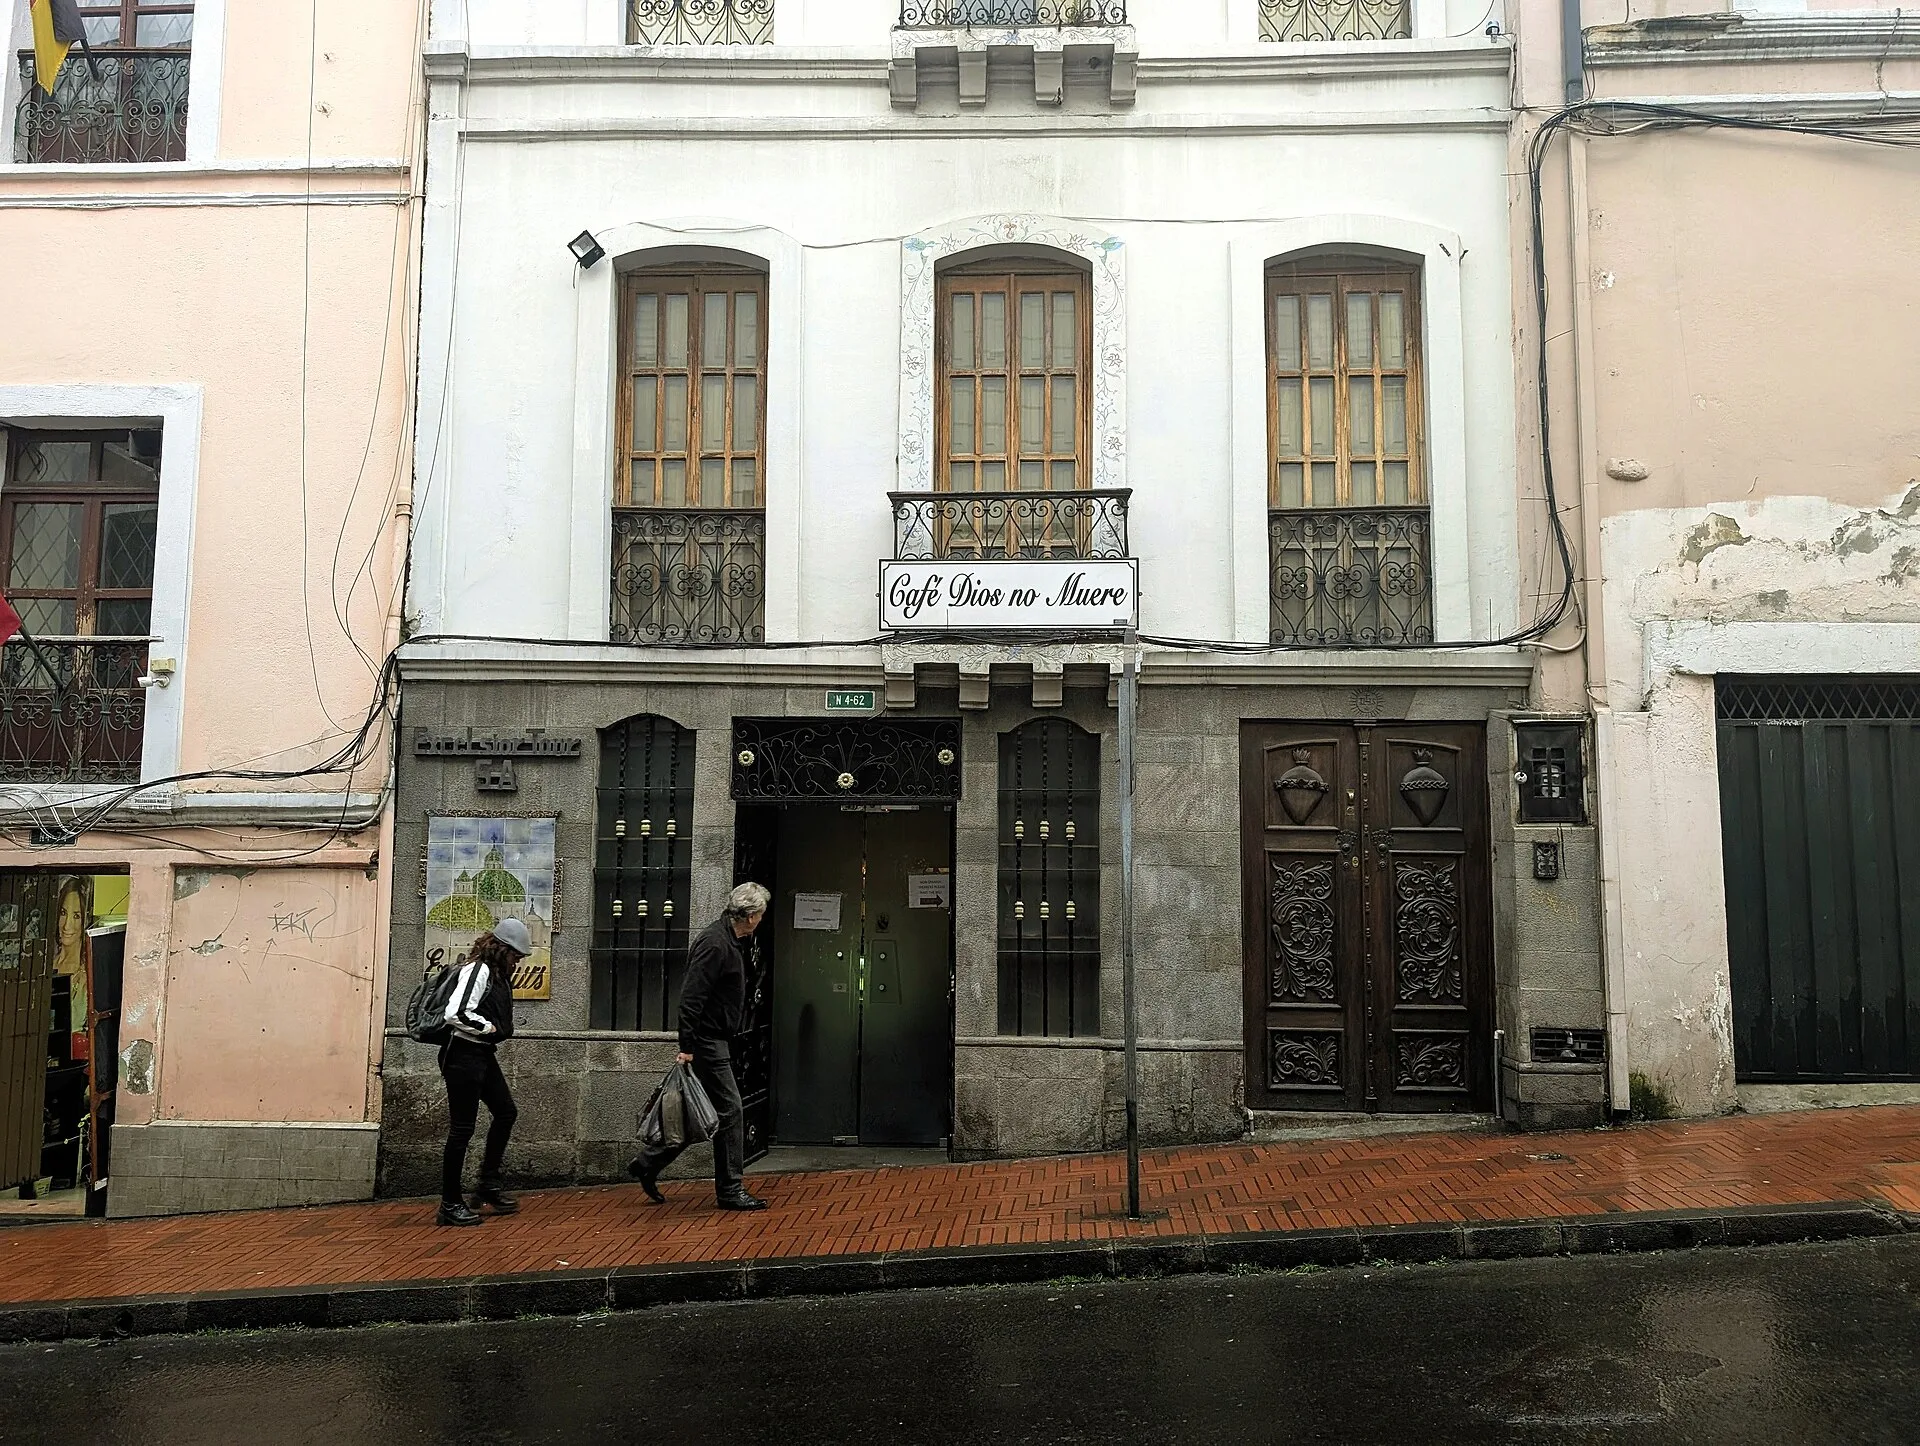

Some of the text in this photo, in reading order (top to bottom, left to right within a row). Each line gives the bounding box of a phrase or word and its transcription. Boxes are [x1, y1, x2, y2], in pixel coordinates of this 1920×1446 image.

[889, 572, 1129, 619] Café Dios no Muere
[836, 695, 865, 706] N 4-62
